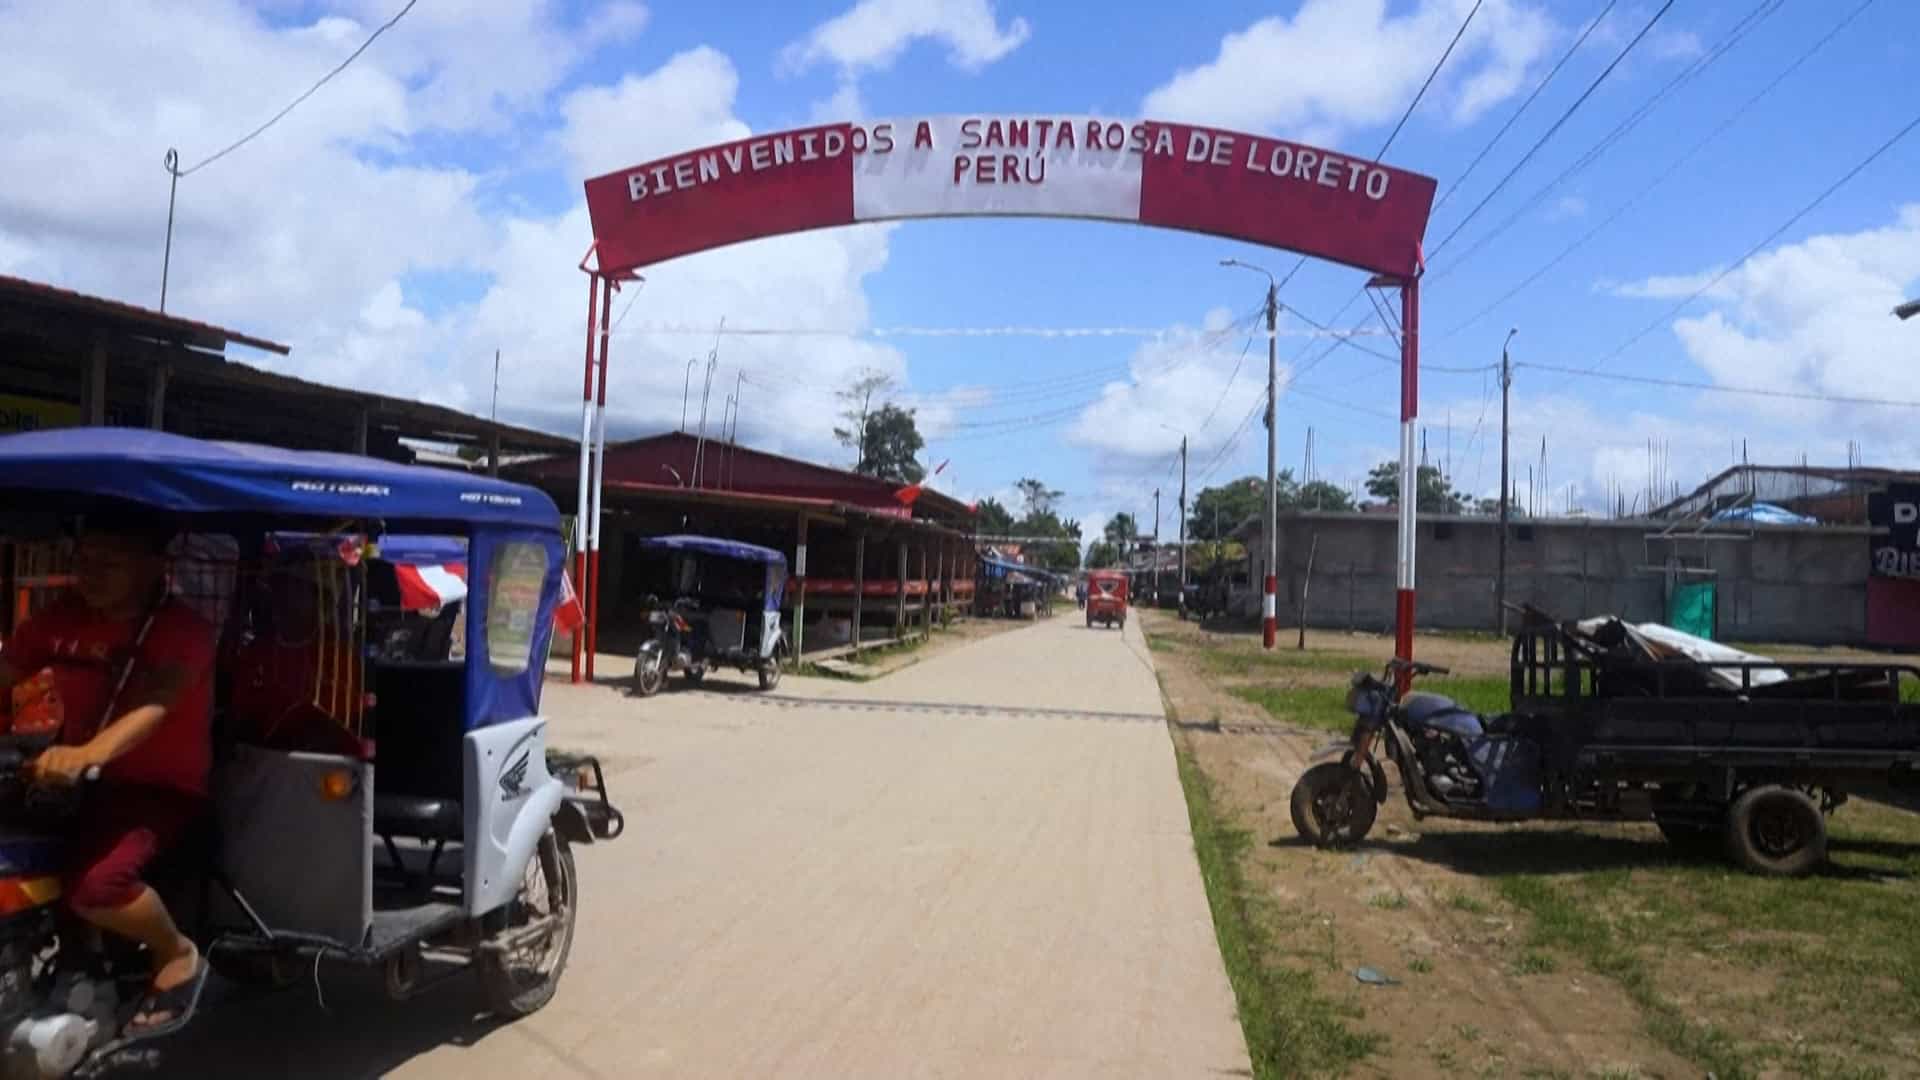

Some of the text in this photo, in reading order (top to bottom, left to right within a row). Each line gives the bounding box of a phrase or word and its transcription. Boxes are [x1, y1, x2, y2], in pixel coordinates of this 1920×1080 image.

[627, 119, 1391, 201] BIENVENIDOS A SANTA ROSA DE LORETO
[953, 150, 1046, 186] PERÚ
